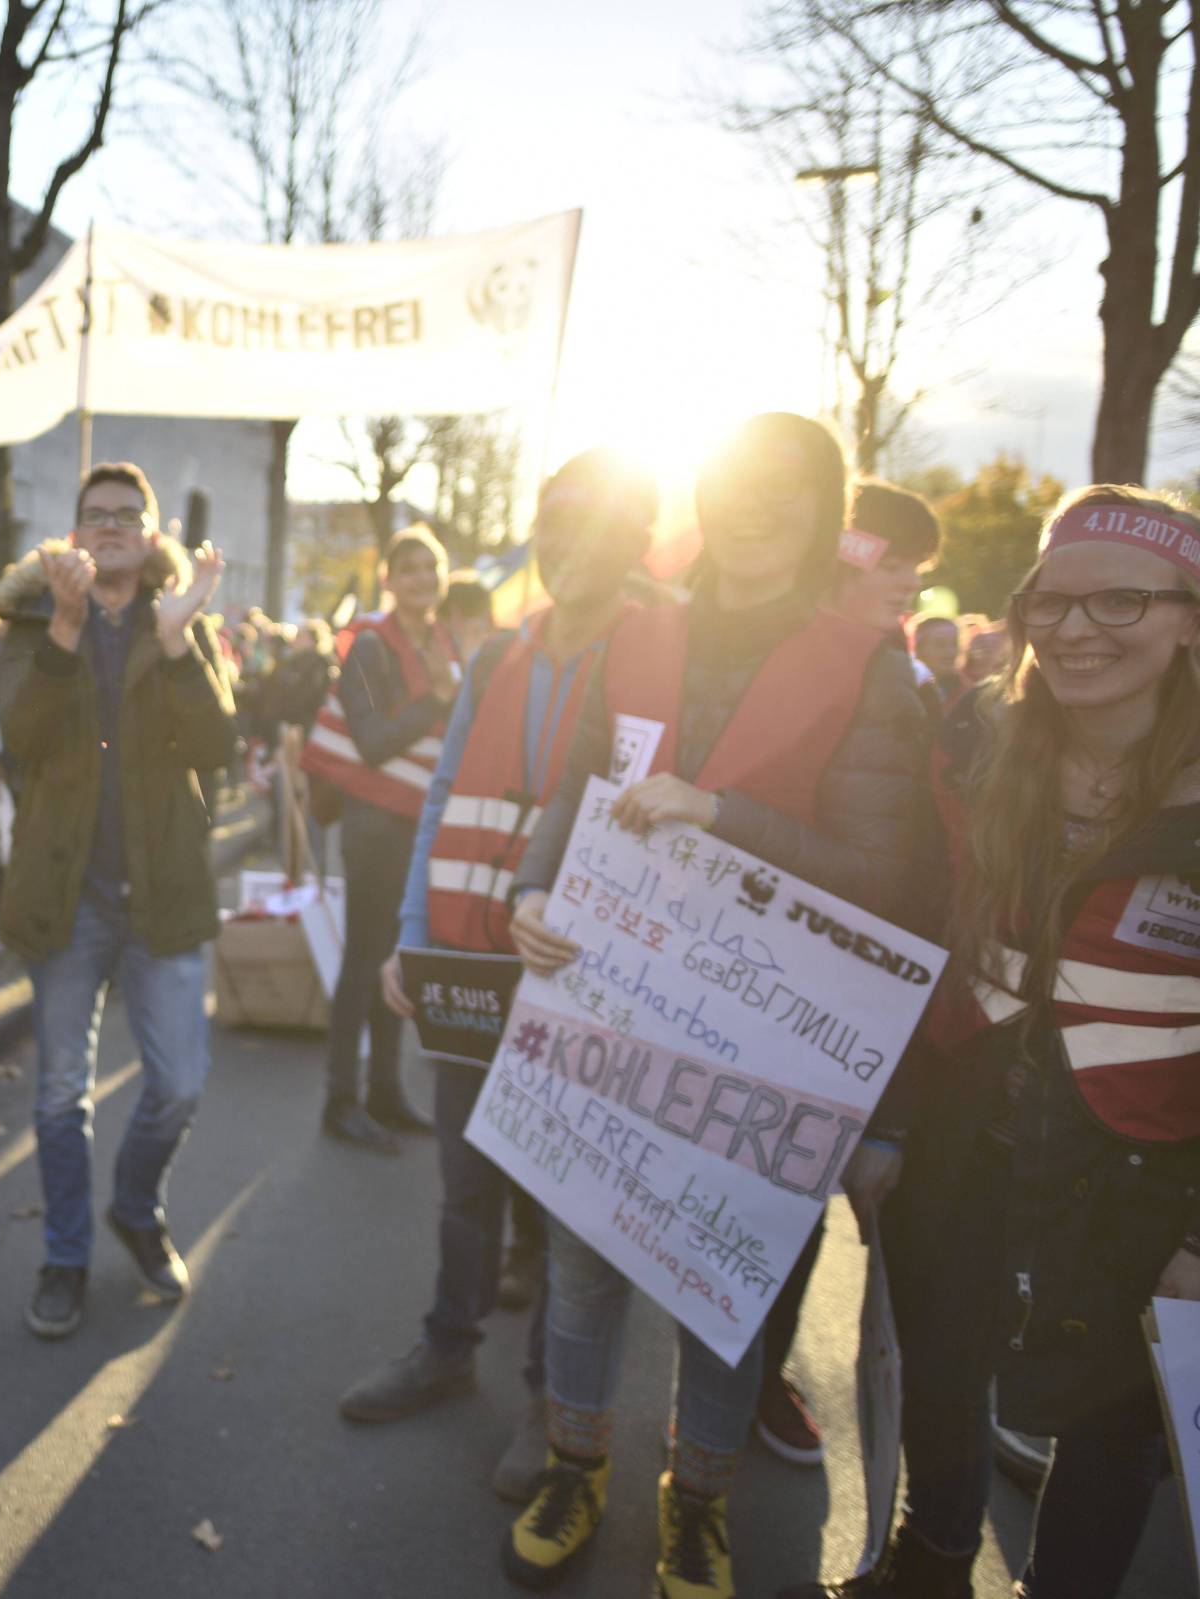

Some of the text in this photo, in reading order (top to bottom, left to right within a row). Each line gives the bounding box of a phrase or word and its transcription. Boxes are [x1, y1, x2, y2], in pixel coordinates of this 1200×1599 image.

[1083, 511, 1180, 548] 4.11.2017
[786, 899, 932, 986] JUGEND
[421, 981, 501, 1012] JE SUIS
[502, 1048, 664, 1183] COAL FREE
[511, 1017, 865, 1202] #KOHLEFREI
